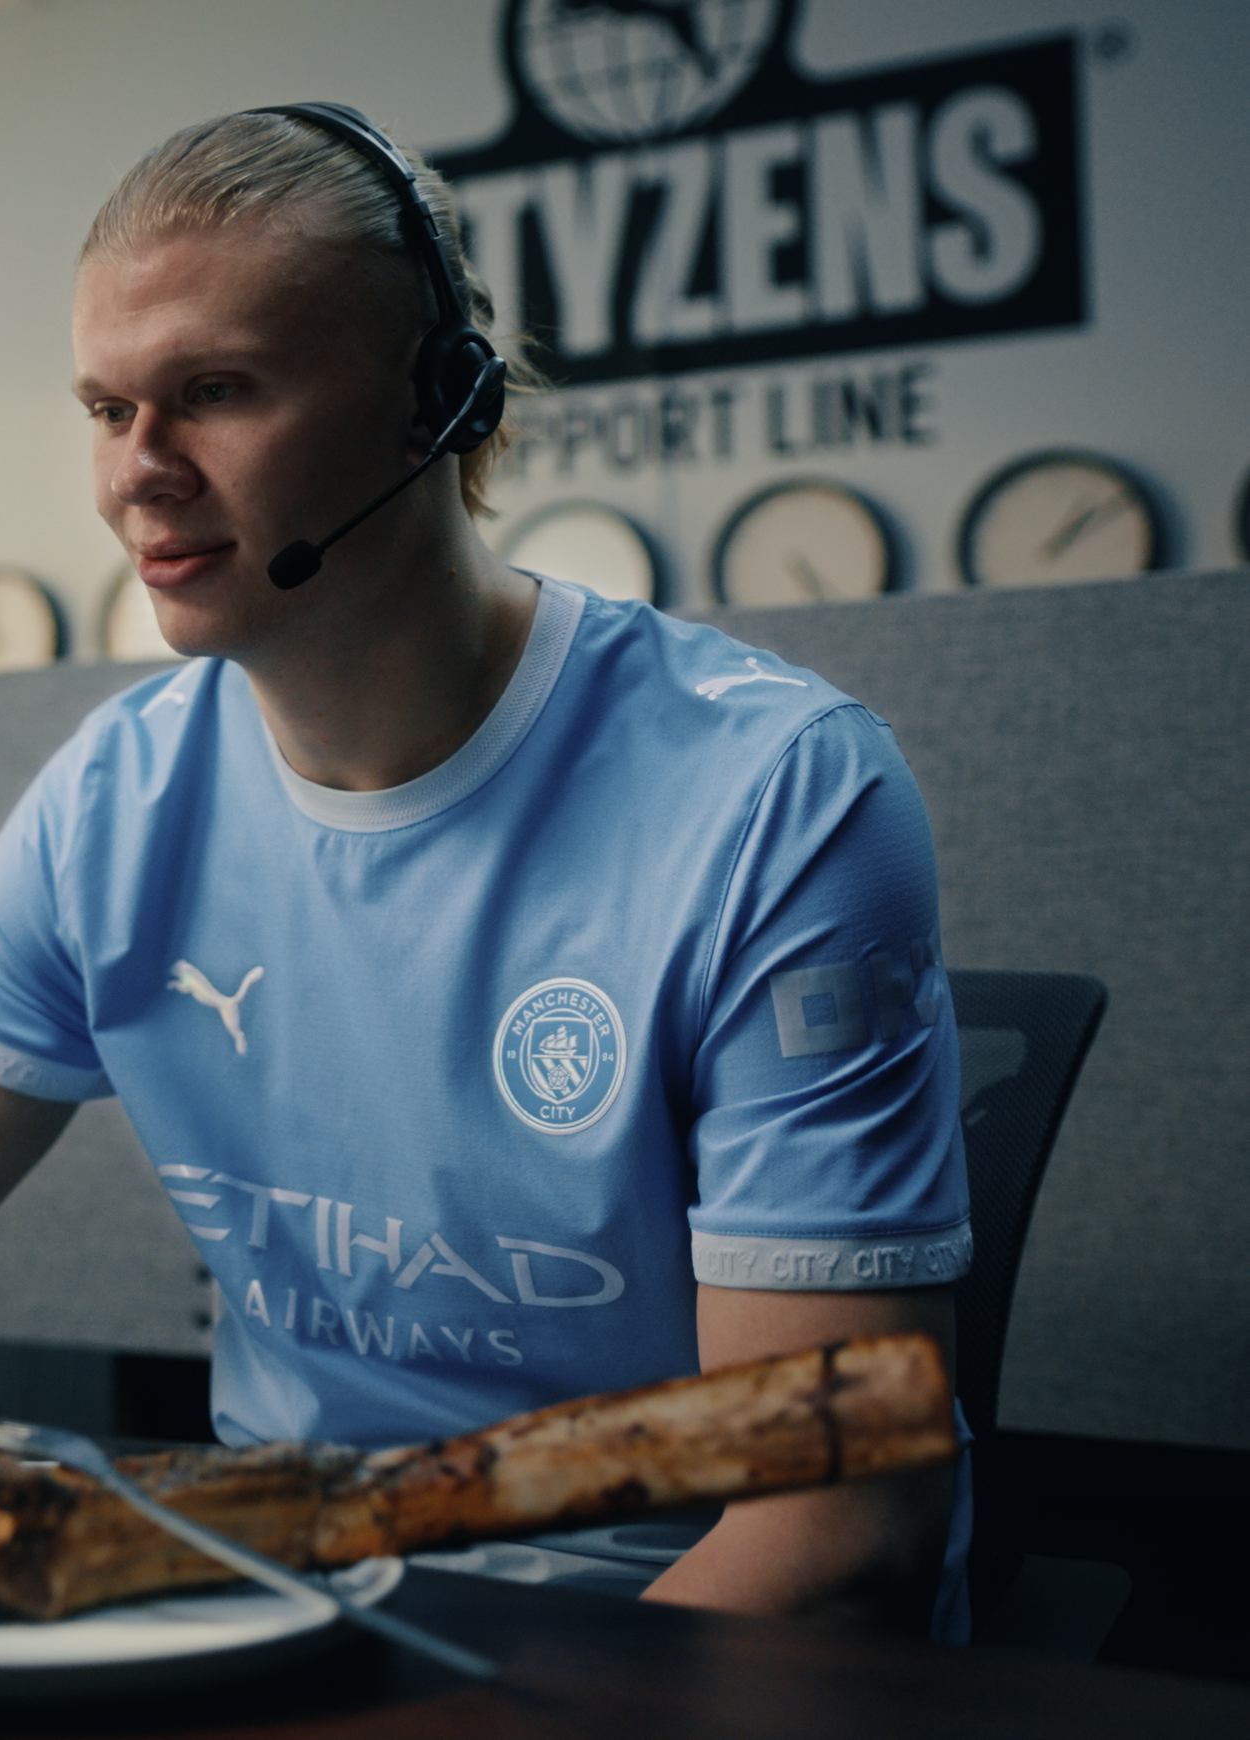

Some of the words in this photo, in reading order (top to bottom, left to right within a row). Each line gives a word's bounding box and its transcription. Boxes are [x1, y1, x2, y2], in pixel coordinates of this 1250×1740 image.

[460, 84, 1045, 366] TYZENS
[502, 382, 734, 480] PPORT
[765, 363, 939, 459] LINE
[511, 991, 611, 1037] MANCHESTER
[506, 1050, 516, 1059] 18
[602, 1052, 614, 1062] 94
[539, 1105, 576, 1120] CITY
[157, 1163, 625, 1308] ETIHAD
[769, 1249, 841, 1281] CITY
[852, 1247, 917, 1279] CITY
[245, 1279, 524, 1367] AIRWAYS
